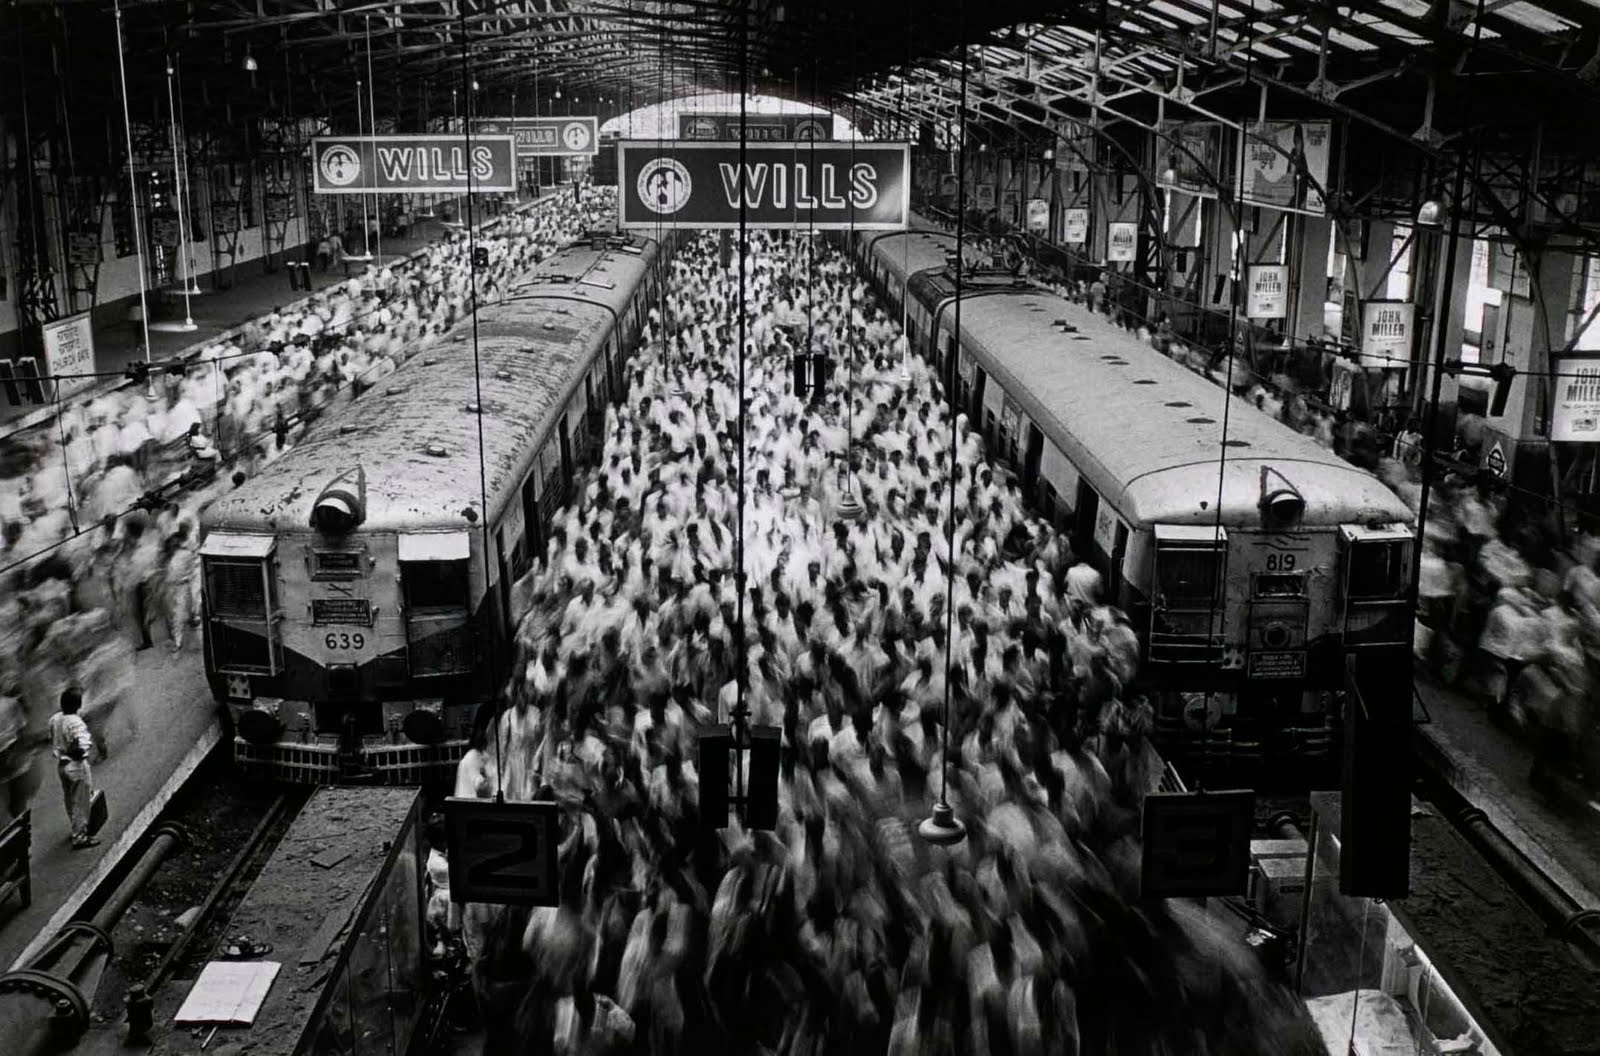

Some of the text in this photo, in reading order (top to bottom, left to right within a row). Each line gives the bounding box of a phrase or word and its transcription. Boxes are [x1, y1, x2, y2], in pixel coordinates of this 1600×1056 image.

[377, 146, 494, 182] WILLS
[718, 162, 878, 209] WILLS
[1259, 271, 1279, 282] JOHN
[1255, 282, 1282, 293] MILLER
[1377, 310, 1401, 323] JOHN
[1371, 323, 1405, 337] MILLER
[1574, 367, 1600, 384] JOH
[1266, 553, 1296, 571] 819
[325, 633, 365, 650] 639
[466, 819, 538, 889] 2
